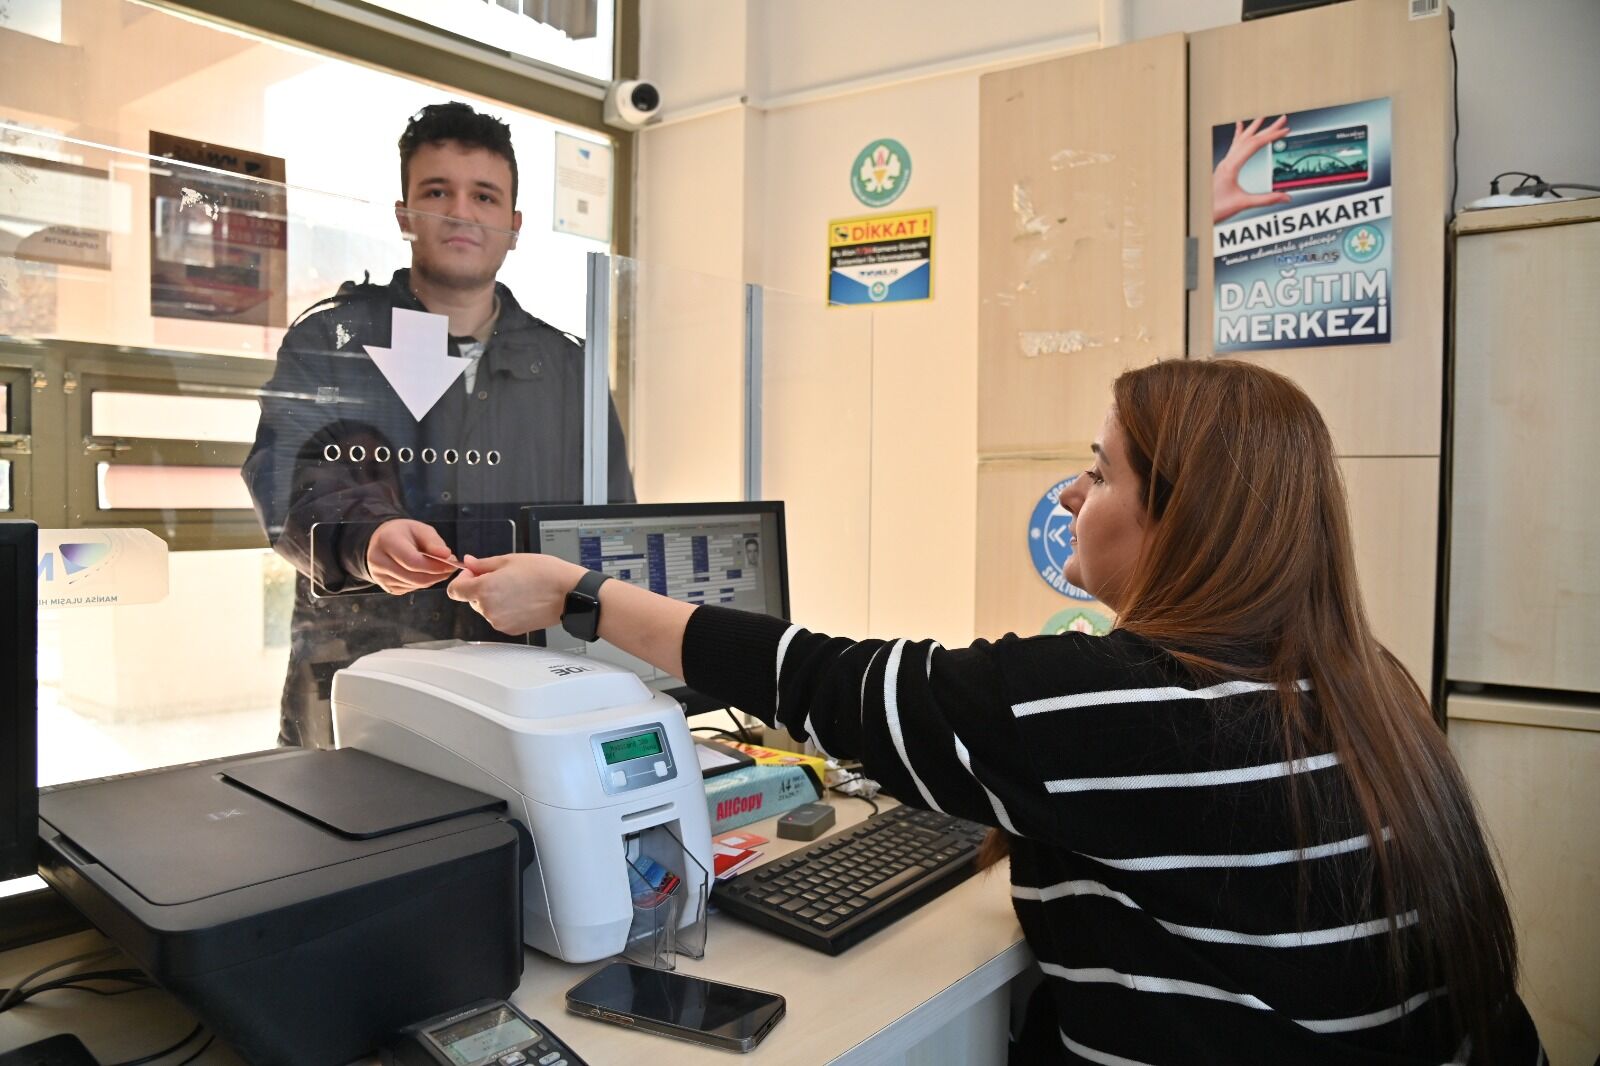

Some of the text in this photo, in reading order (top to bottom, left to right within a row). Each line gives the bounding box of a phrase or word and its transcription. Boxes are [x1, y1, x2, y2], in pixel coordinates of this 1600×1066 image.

[852, 218, 930, 241] DİKKAT !
[1218, 194, 1384, 248] MANİSAKART
[1219, 268, 1387, 311] DAĞITIM
[1219, 299, 1388, 344] MERKEZİ
[778, 778, 792, 794] A4
[716, 792, 764, 822] AllCopy
